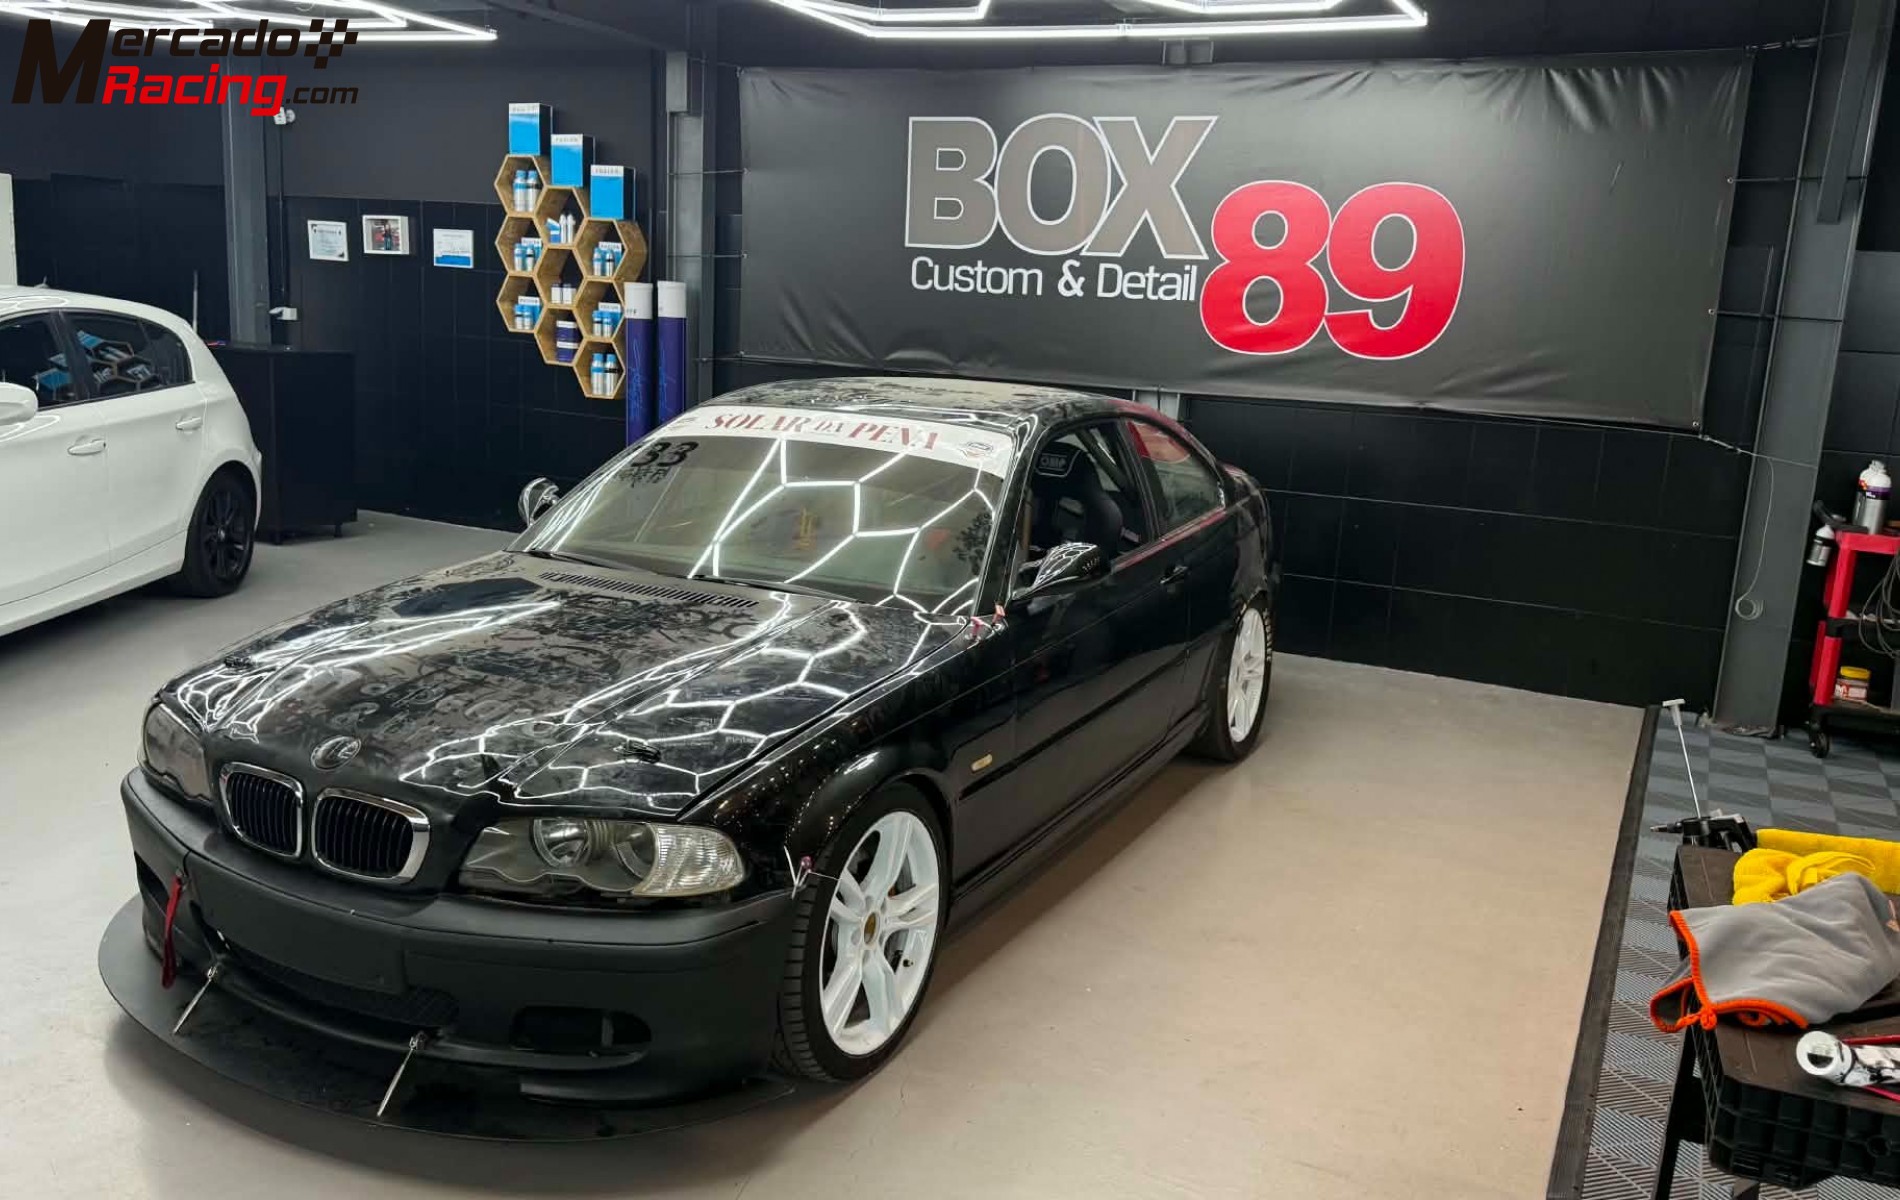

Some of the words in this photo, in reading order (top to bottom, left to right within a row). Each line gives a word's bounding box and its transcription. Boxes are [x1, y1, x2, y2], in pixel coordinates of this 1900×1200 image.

[905, 113, 1218, 259] BOX
[1200, 180, 1465, 360] 89
[911, 256, 1042, 296] Custom
[1057, 261, 1084, 298] &
[1096, 262, 1197, 301] Detail
[705, 412, 811, 433] SOLAR
[631, 441, 699, 467] 33
